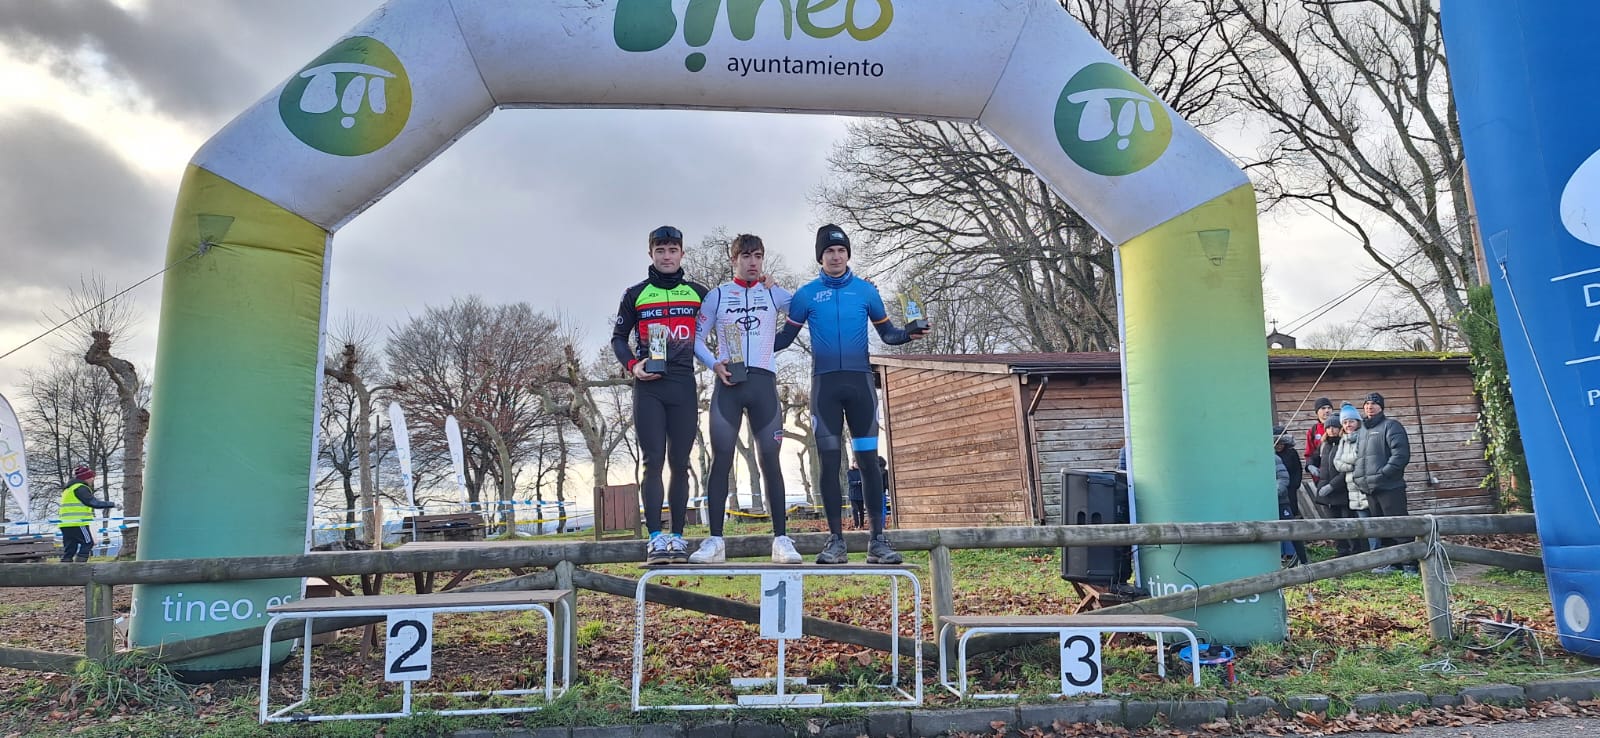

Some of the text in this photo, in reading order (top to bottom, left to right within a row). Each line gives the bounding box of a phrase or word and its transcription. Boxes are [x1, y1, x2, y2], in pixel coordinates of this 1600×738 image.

[727, 55, 884, 77] ayuntamiento
[725, 305, 769, 314] MMR
[812, 289, 833, 301] JPS
[764, 580, 787, 634] 1
[389, 619, 428, 674] 2
[1063, 635, 1099, 687] 3
